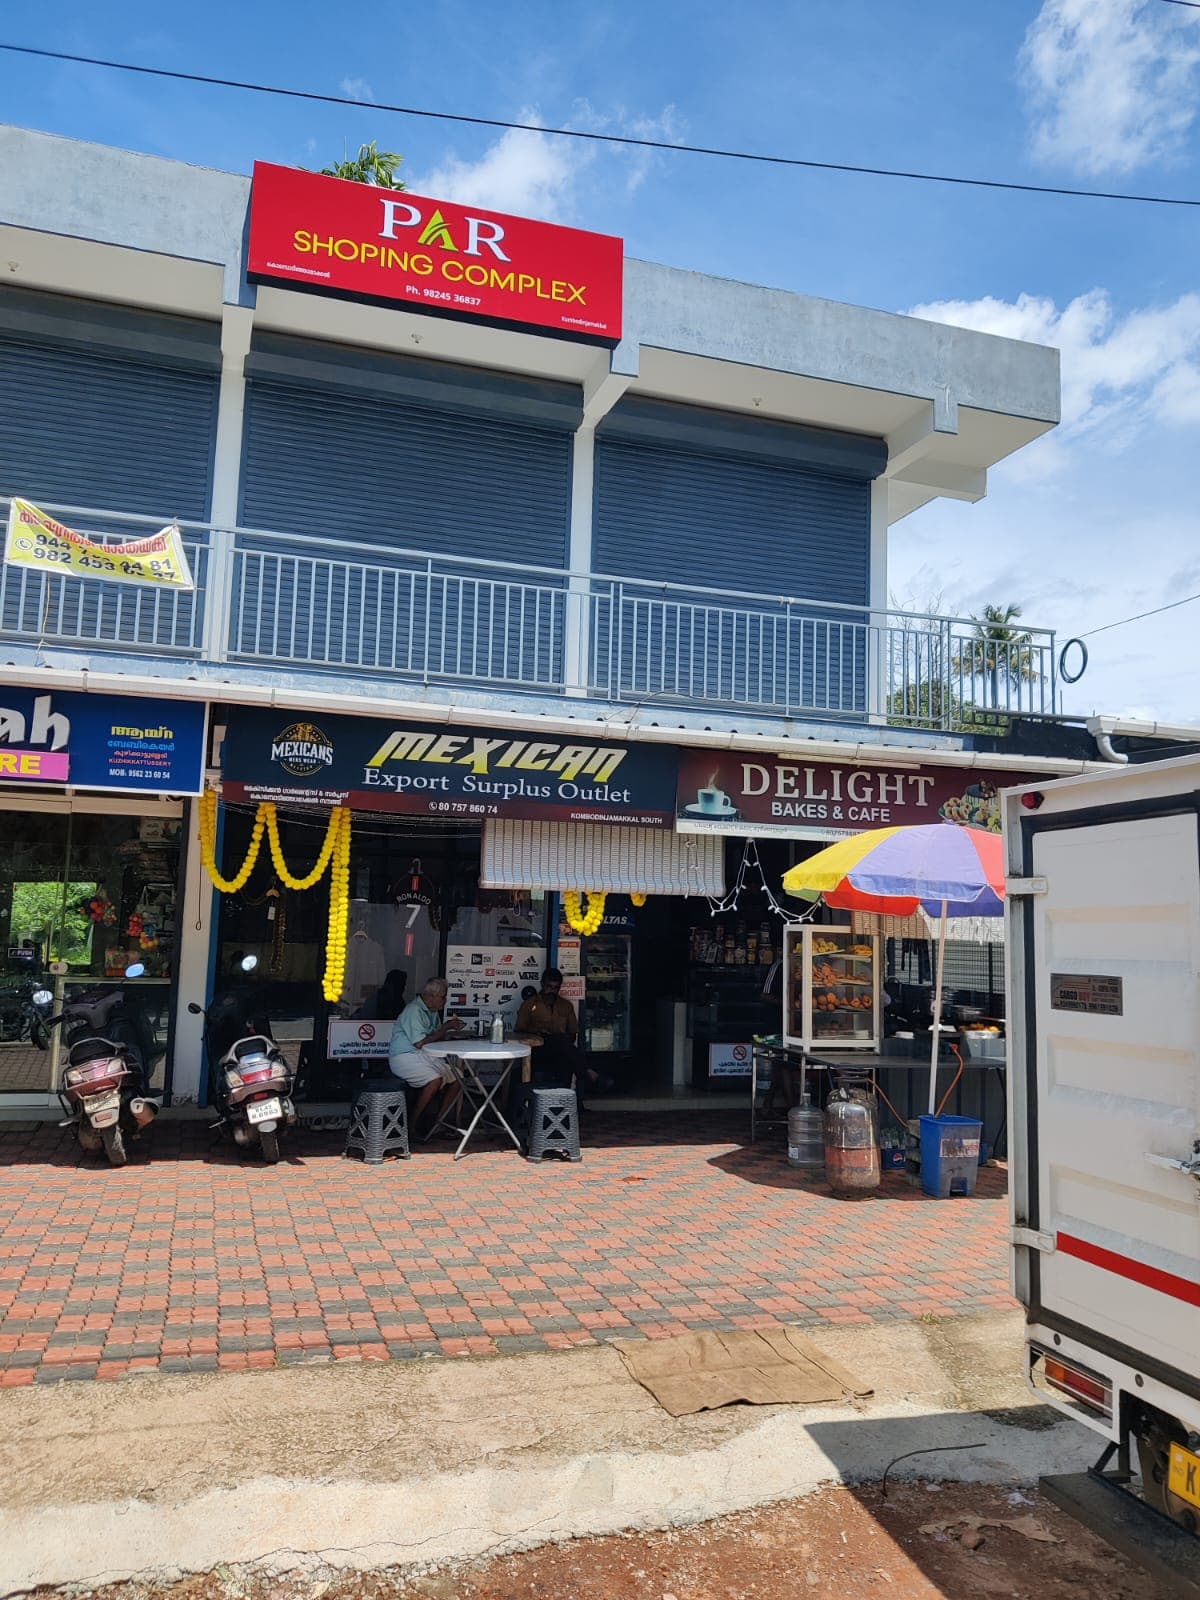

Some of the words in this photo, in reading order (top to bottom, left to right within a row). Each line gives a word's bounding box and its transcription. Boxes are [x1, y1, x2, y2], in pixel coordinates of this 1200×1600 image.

[379, 198, 511, 262] PAR
[293, 230, 434, 275] SHOPING
[441, 260, 587, 305] COMPLEX
[405, 285, 421, 296] Ph.
[423, 288, 451, 301] 98245
[453, 292, 481, 306] 36837
[32, 547, 72, 564] 982
[78, 556, 115, 571] 453
[35, 534, 72, 551] 944
[150, 558, 173, 571] 81
[271, 741, 334, 766] MEXICANS
[366, 731, 628, 782] MEXICAN
[362, 768, 450, 792] Export
[462, 775, 551, 799] Surplus
[558, 783, 631, 803] Outlet
[740, 763, 935, 807] DELIGHT
[438, 803, 449, 812] 80
[451, 803, 468, 812] 757
[487, 805, 498, 814] 74
[641, 816, 663, 824] SOUTH
[771, 802, 828, 819] BAKES
[832, 805, 843, 820] &
[848, 806, 891, 822] CAFE
[396, 892, 432, 905] RONALDO
[405, 903, 421, 928] 7
[603, 916, 628, 925] LTAS
[496, 980, 518, 989] FILA
[518, 971, 540, 981] VANS
